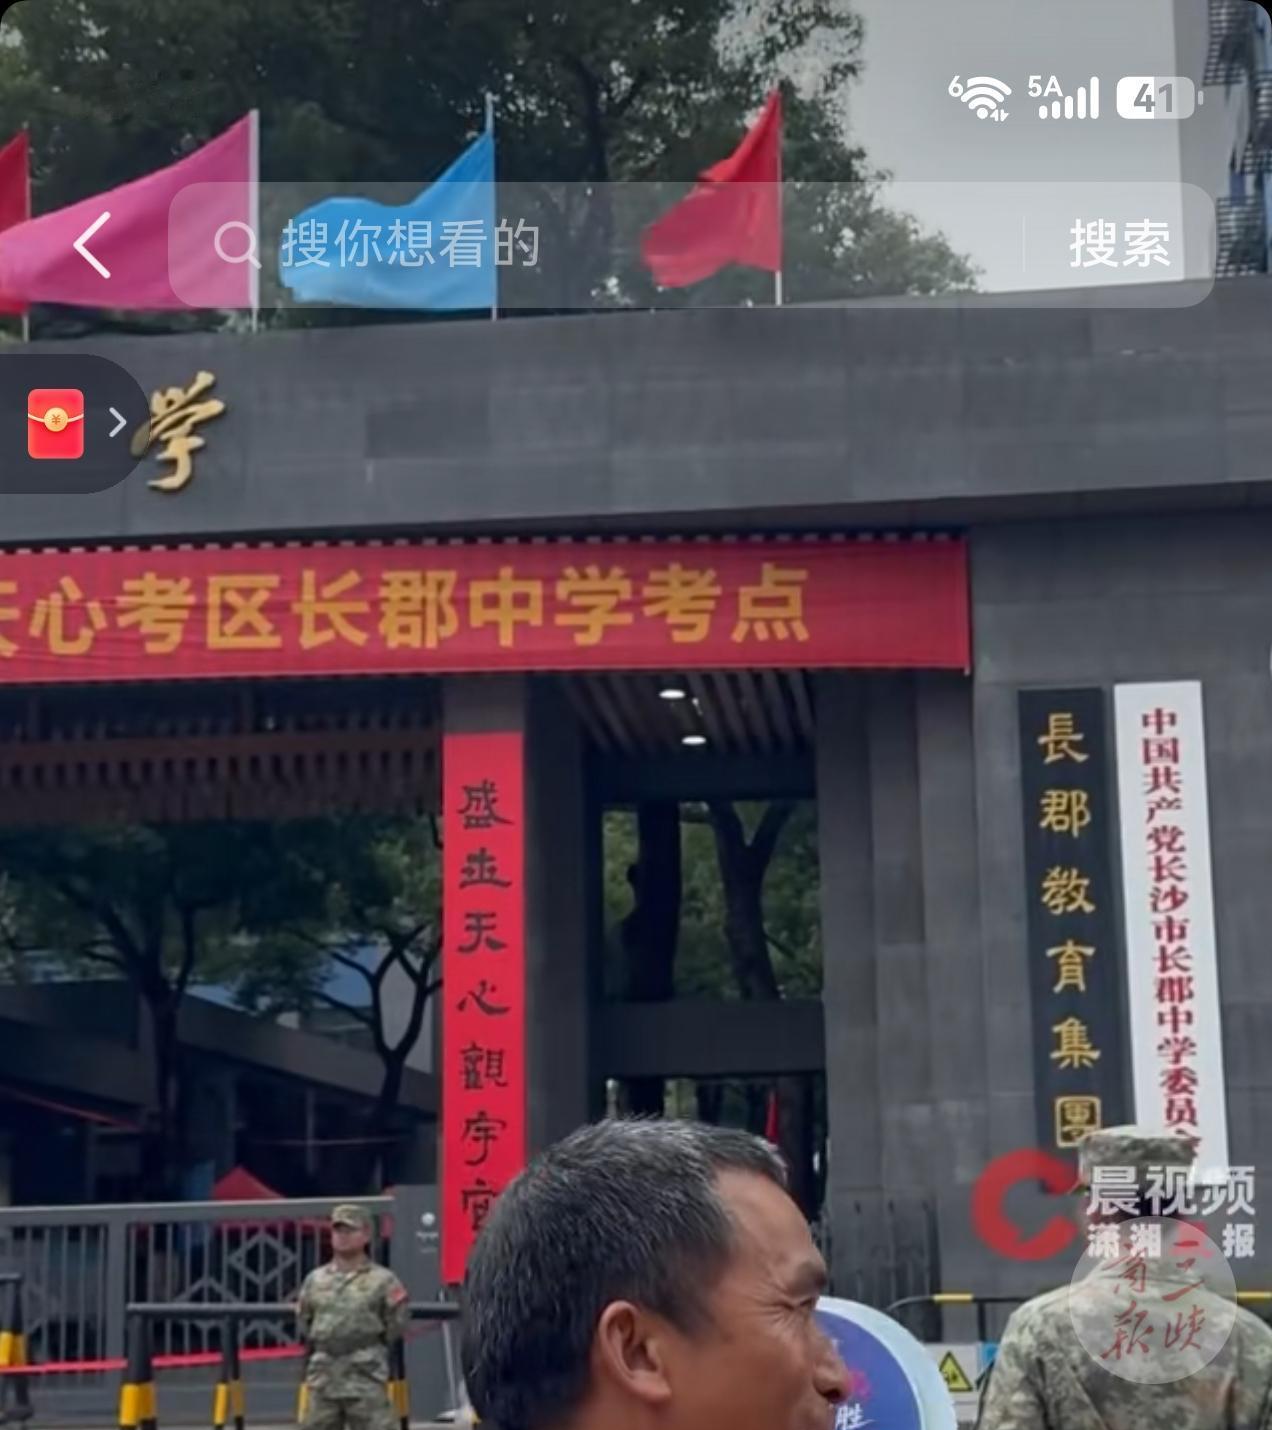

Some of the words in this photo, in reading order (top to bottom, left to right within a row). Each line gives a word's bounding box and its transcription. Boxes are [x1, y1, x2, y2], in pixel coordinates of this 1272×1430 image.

[0, 563, 810, 658] 心考区长郡中学考点
